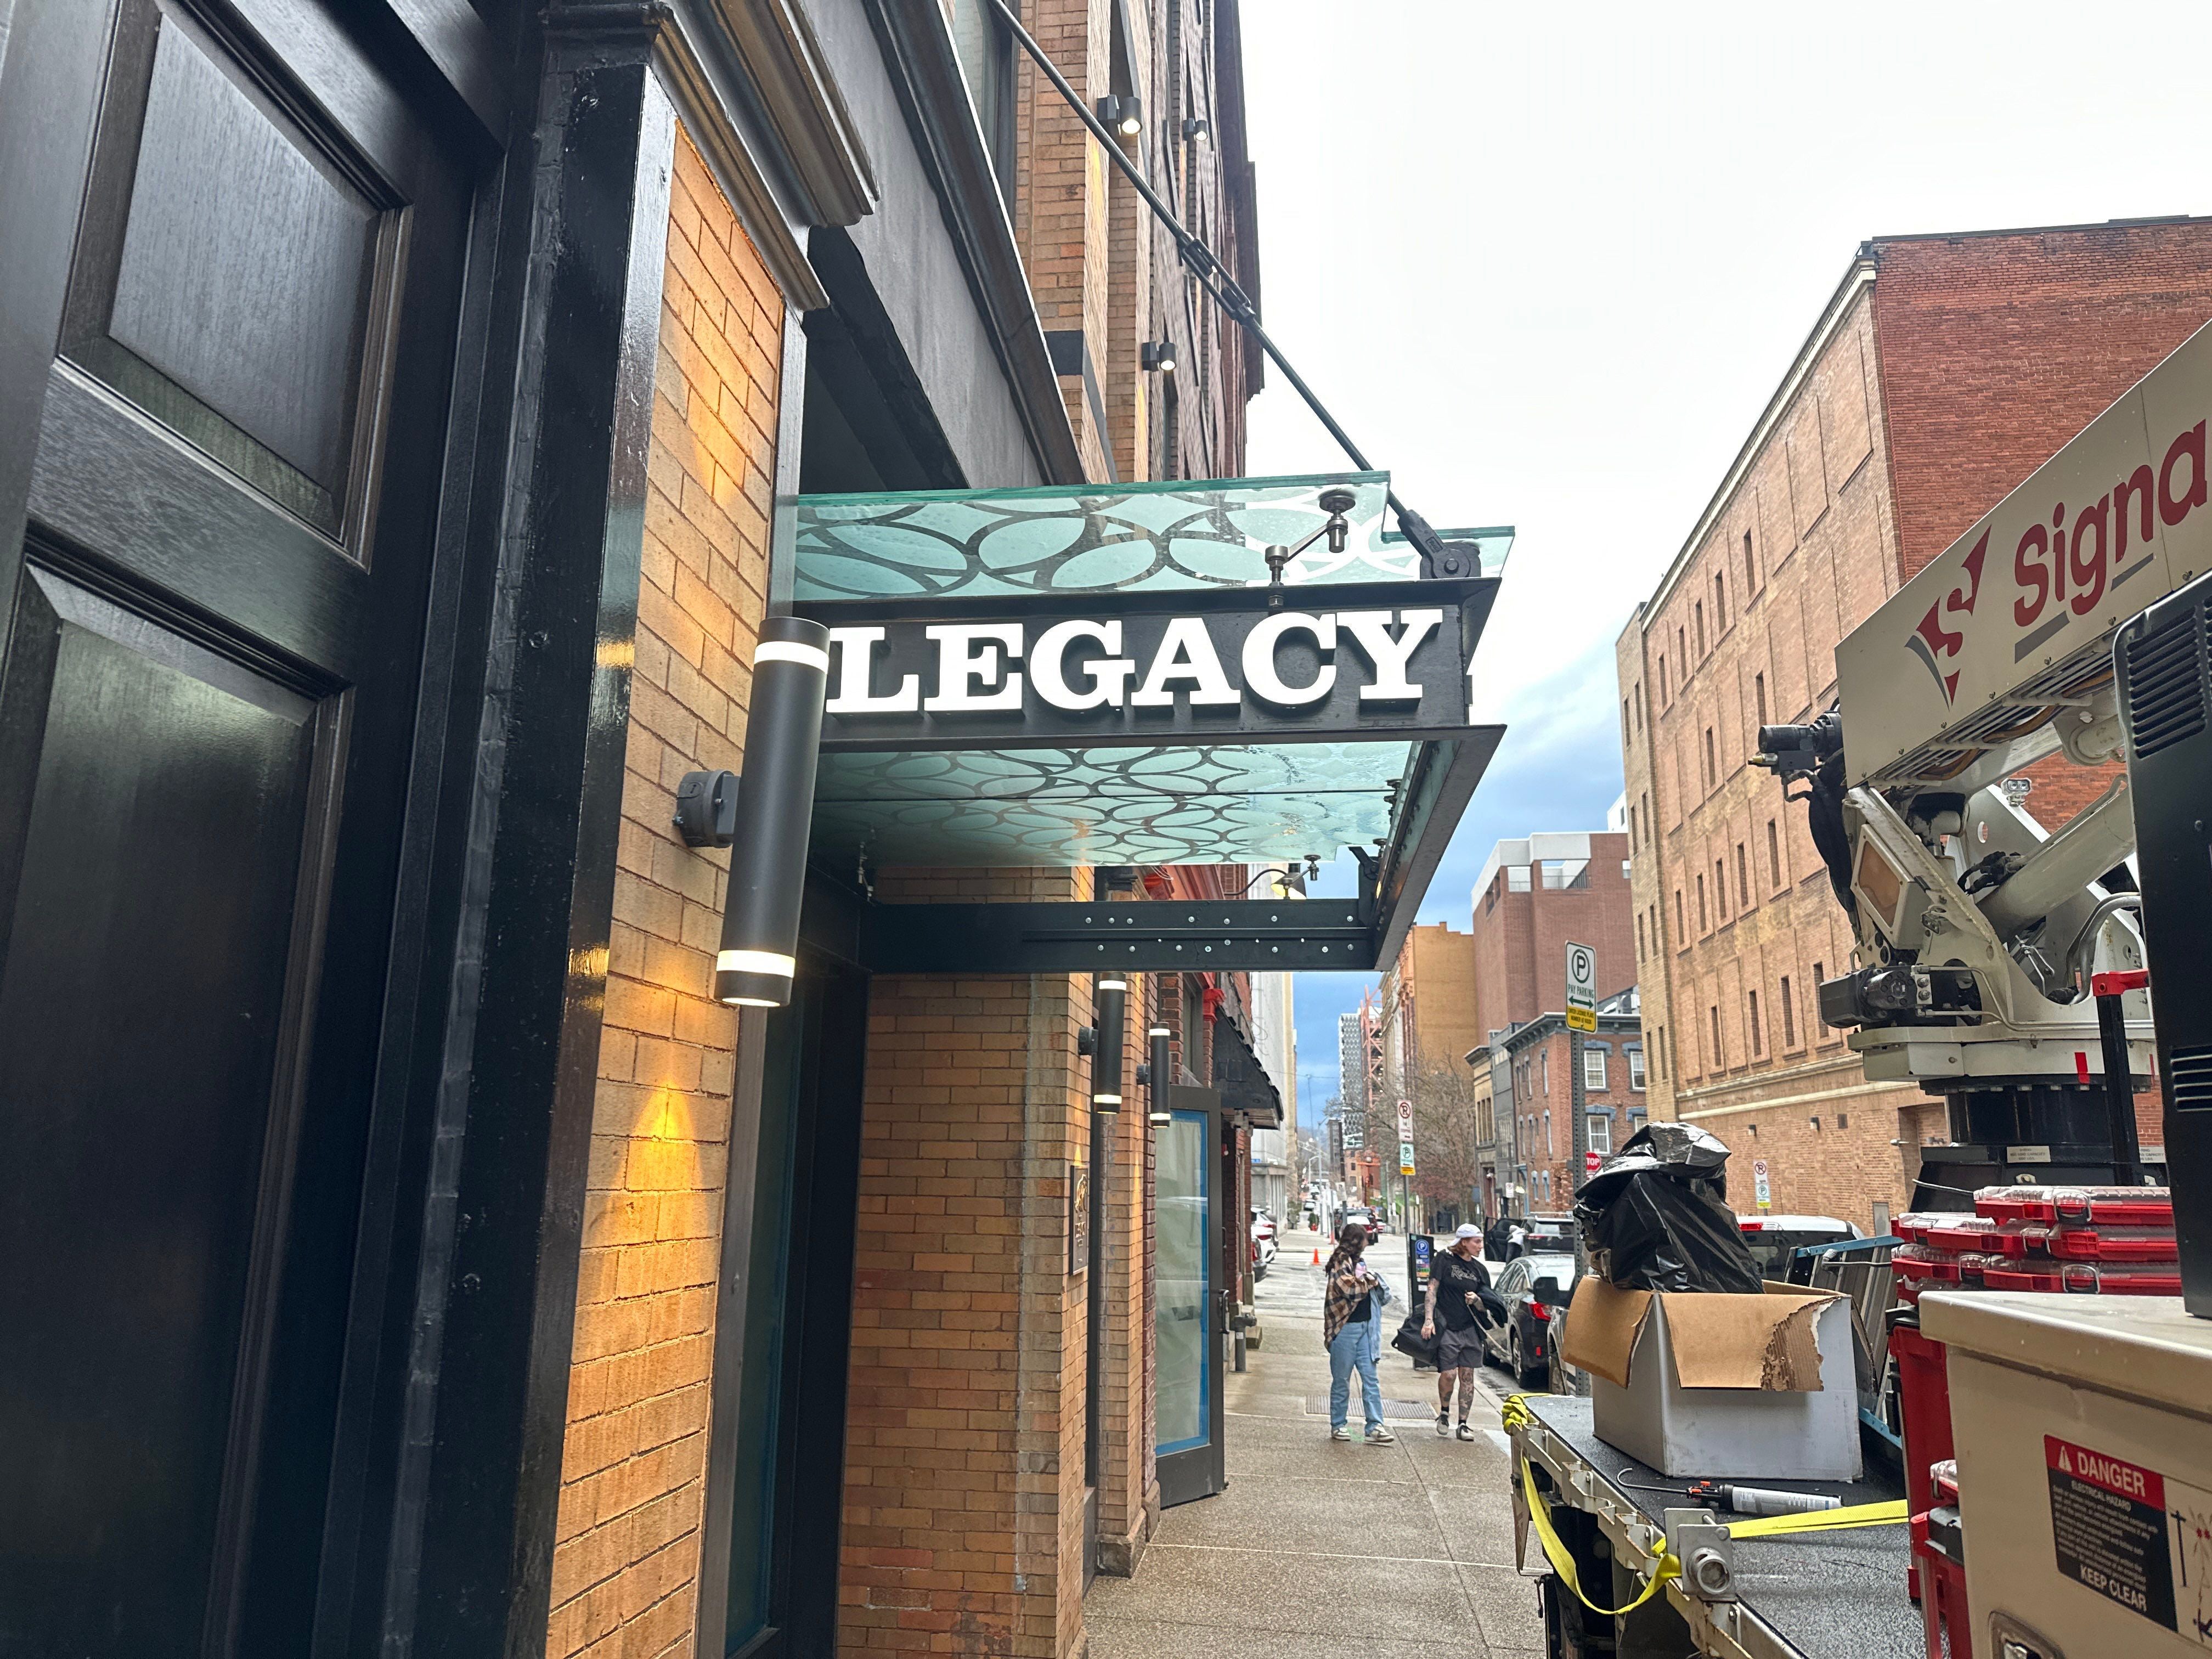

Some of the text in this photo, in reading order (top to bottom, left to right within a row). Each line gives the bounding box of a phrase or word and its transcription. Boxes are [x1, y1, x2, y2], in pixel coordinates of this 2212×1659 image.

[2014, 419, 2207, 627] Signa
[826, 609, 1442, 713] LEGACY
[1577, 955, 1586, 977] P
[1577, 986, 1594, 998] PARKING
[1586, 1158, 1600, 1166] TOP
[2077, 1451, 2146, 1498] DANGER
[2080, 1563, 2147, 1612] KEEP CLEAR
